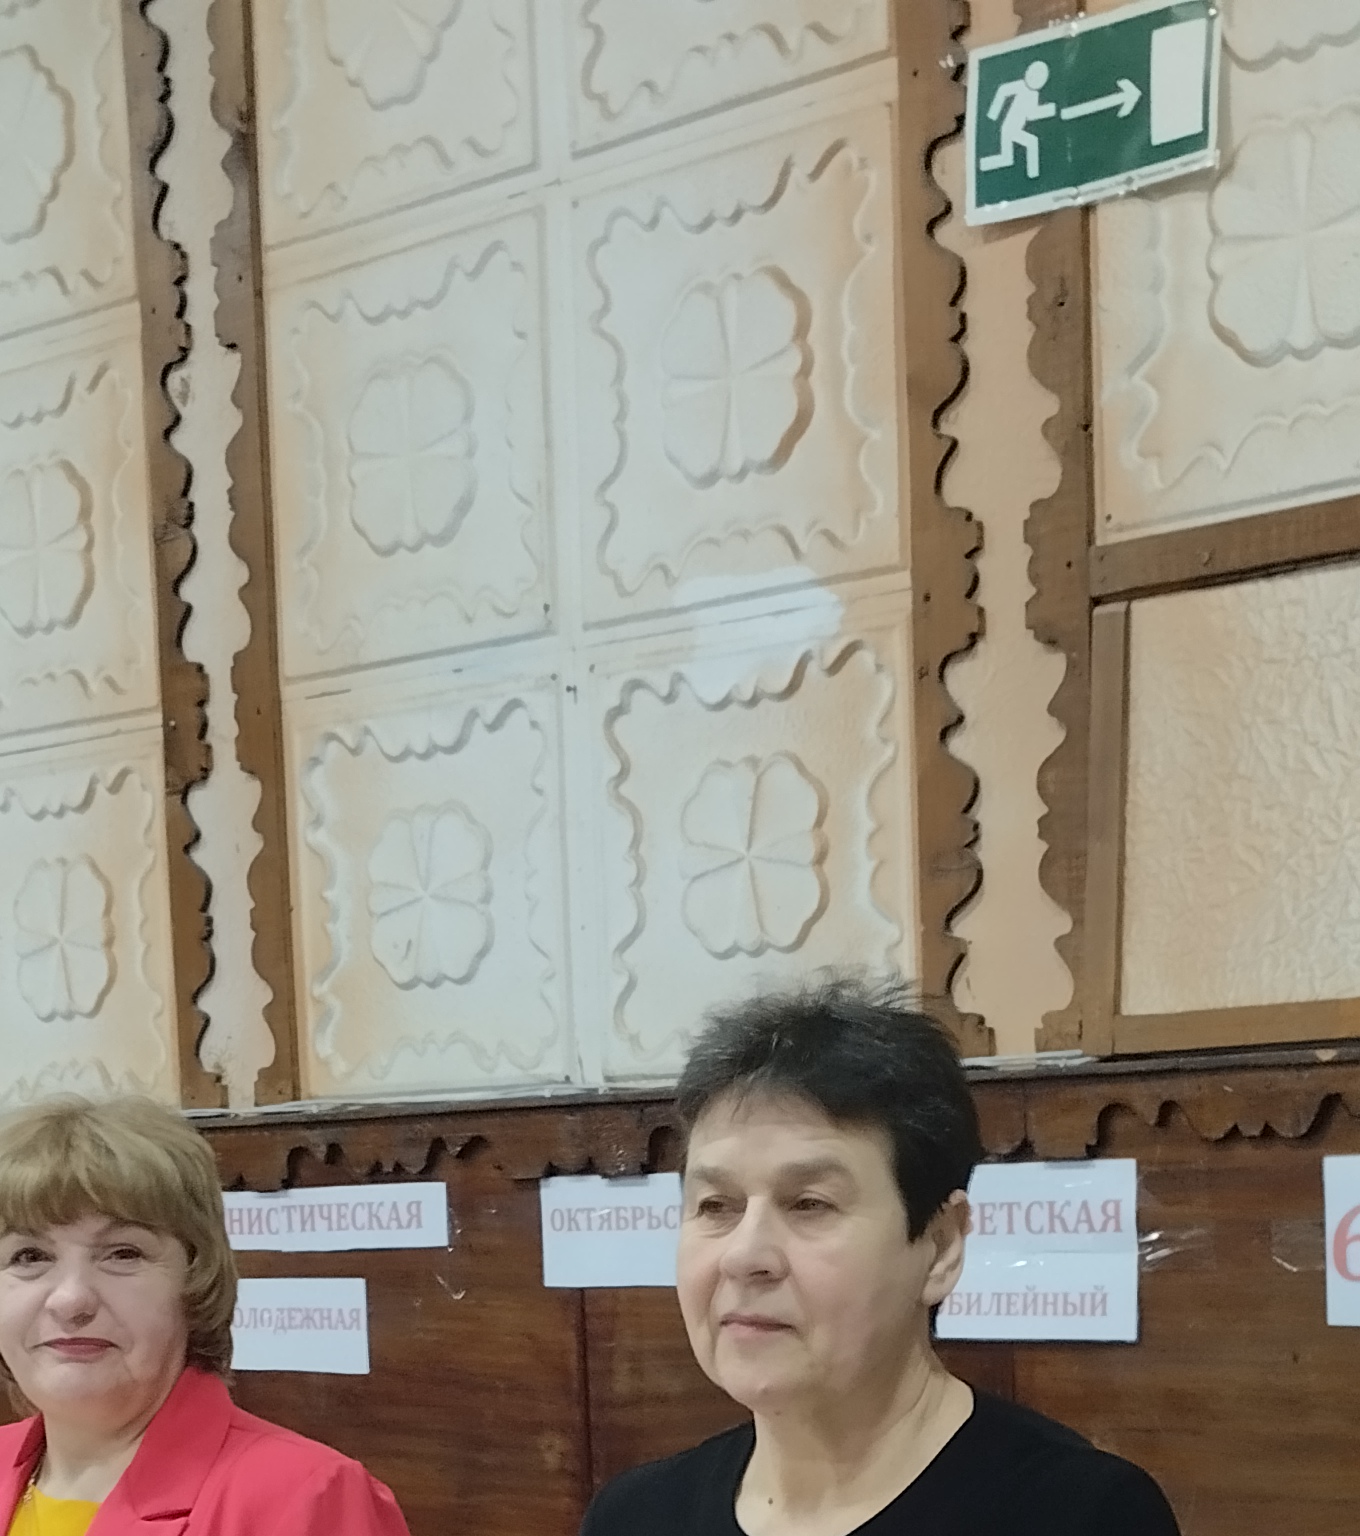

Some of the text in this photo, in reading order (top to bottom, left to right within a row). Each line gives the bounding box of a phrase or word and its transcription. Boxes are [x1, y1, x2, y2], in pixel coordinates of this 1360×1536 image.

[226, 1200, 423, 1236] НИСТИЧЕСКАЯ
[973, 1199, 1124, 1236] ЕТСКАЯ
[940, 1285, 1109, 1318] БИЛЕЙНЫЙ
